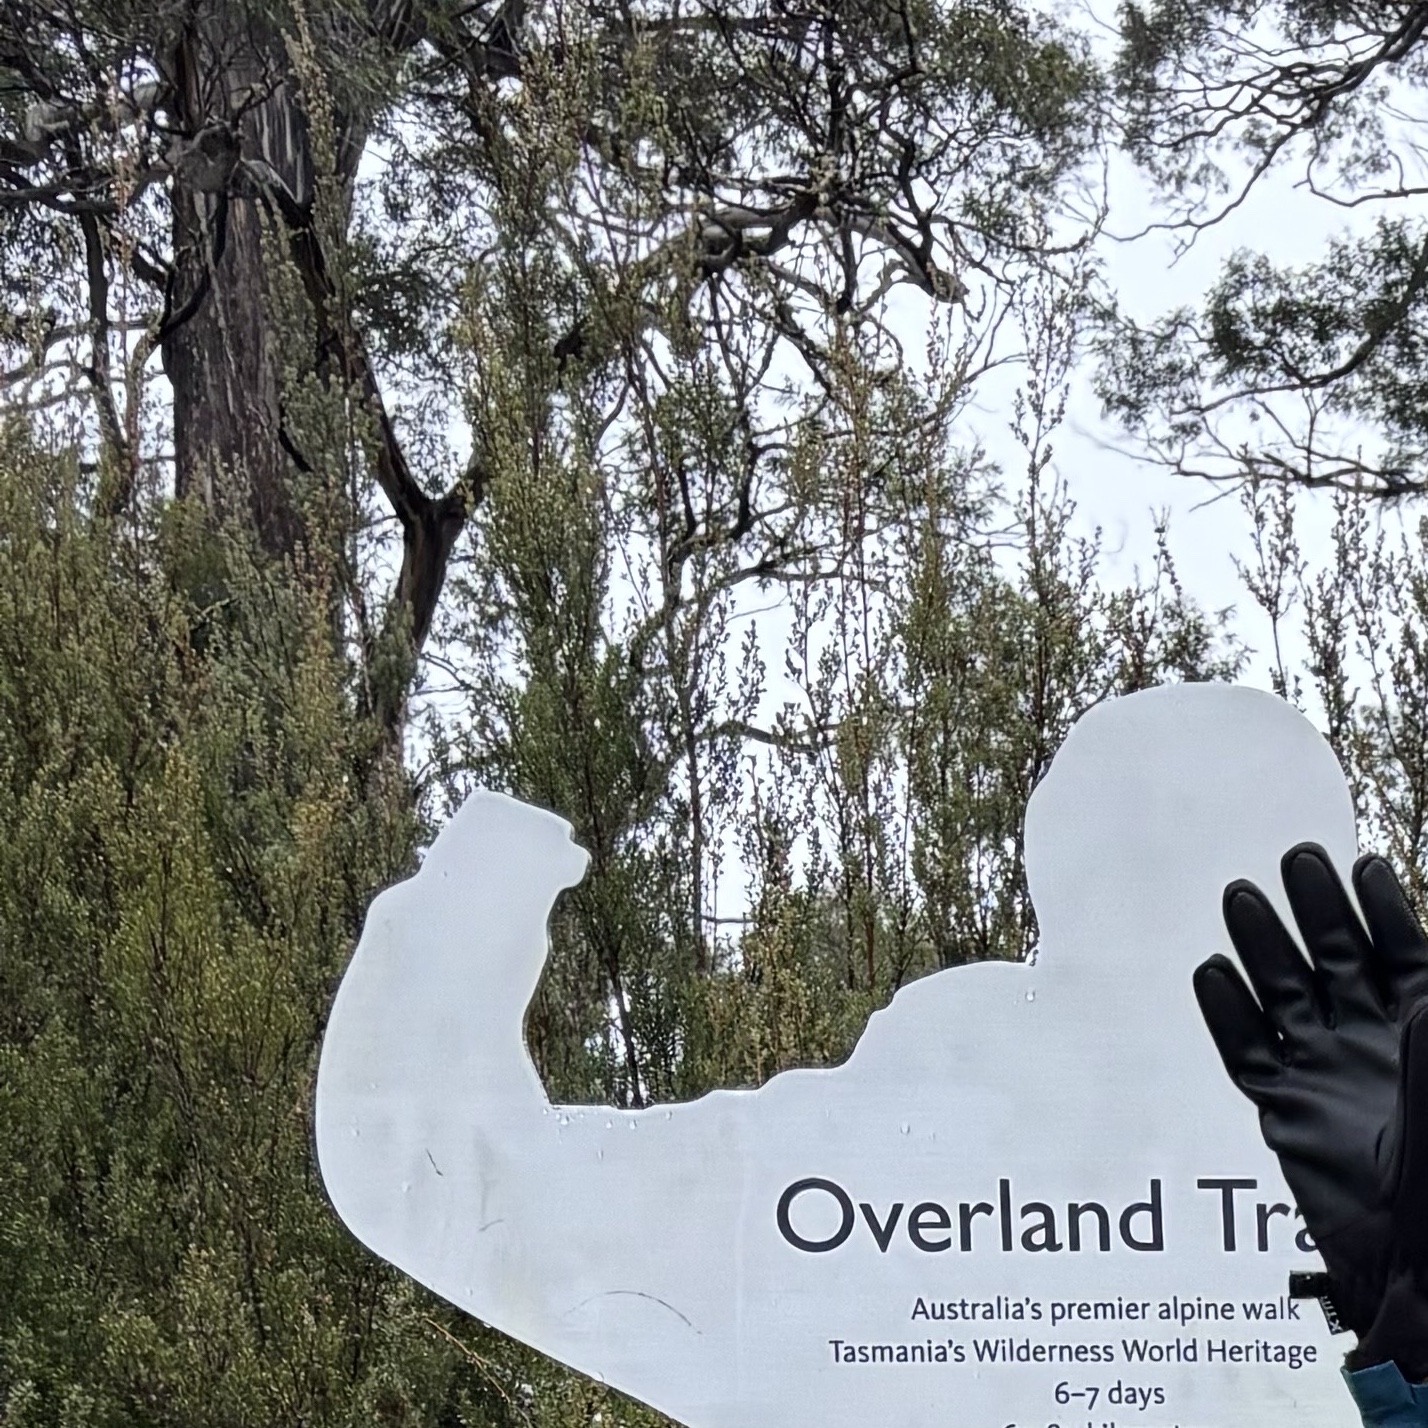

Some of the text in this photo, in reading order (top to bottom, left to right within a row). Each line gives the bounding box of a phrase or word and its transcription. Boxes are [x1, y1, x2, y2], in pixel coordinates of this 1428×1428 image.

[777, 1178, 1164, 1253] Overland
[1050, 1296, 1151, 1327] premier
[1158, 1295, 1235, 1327] alpine
[1242, 1295, 1301, 1320] walk
[972, 1337, 1115, 1363] Wilderness
[1121, 1337, 1198, 1363] World
[1207, 1339, 1317, 1370] Heritage
[1107, 1379, 1165, 1412] days
